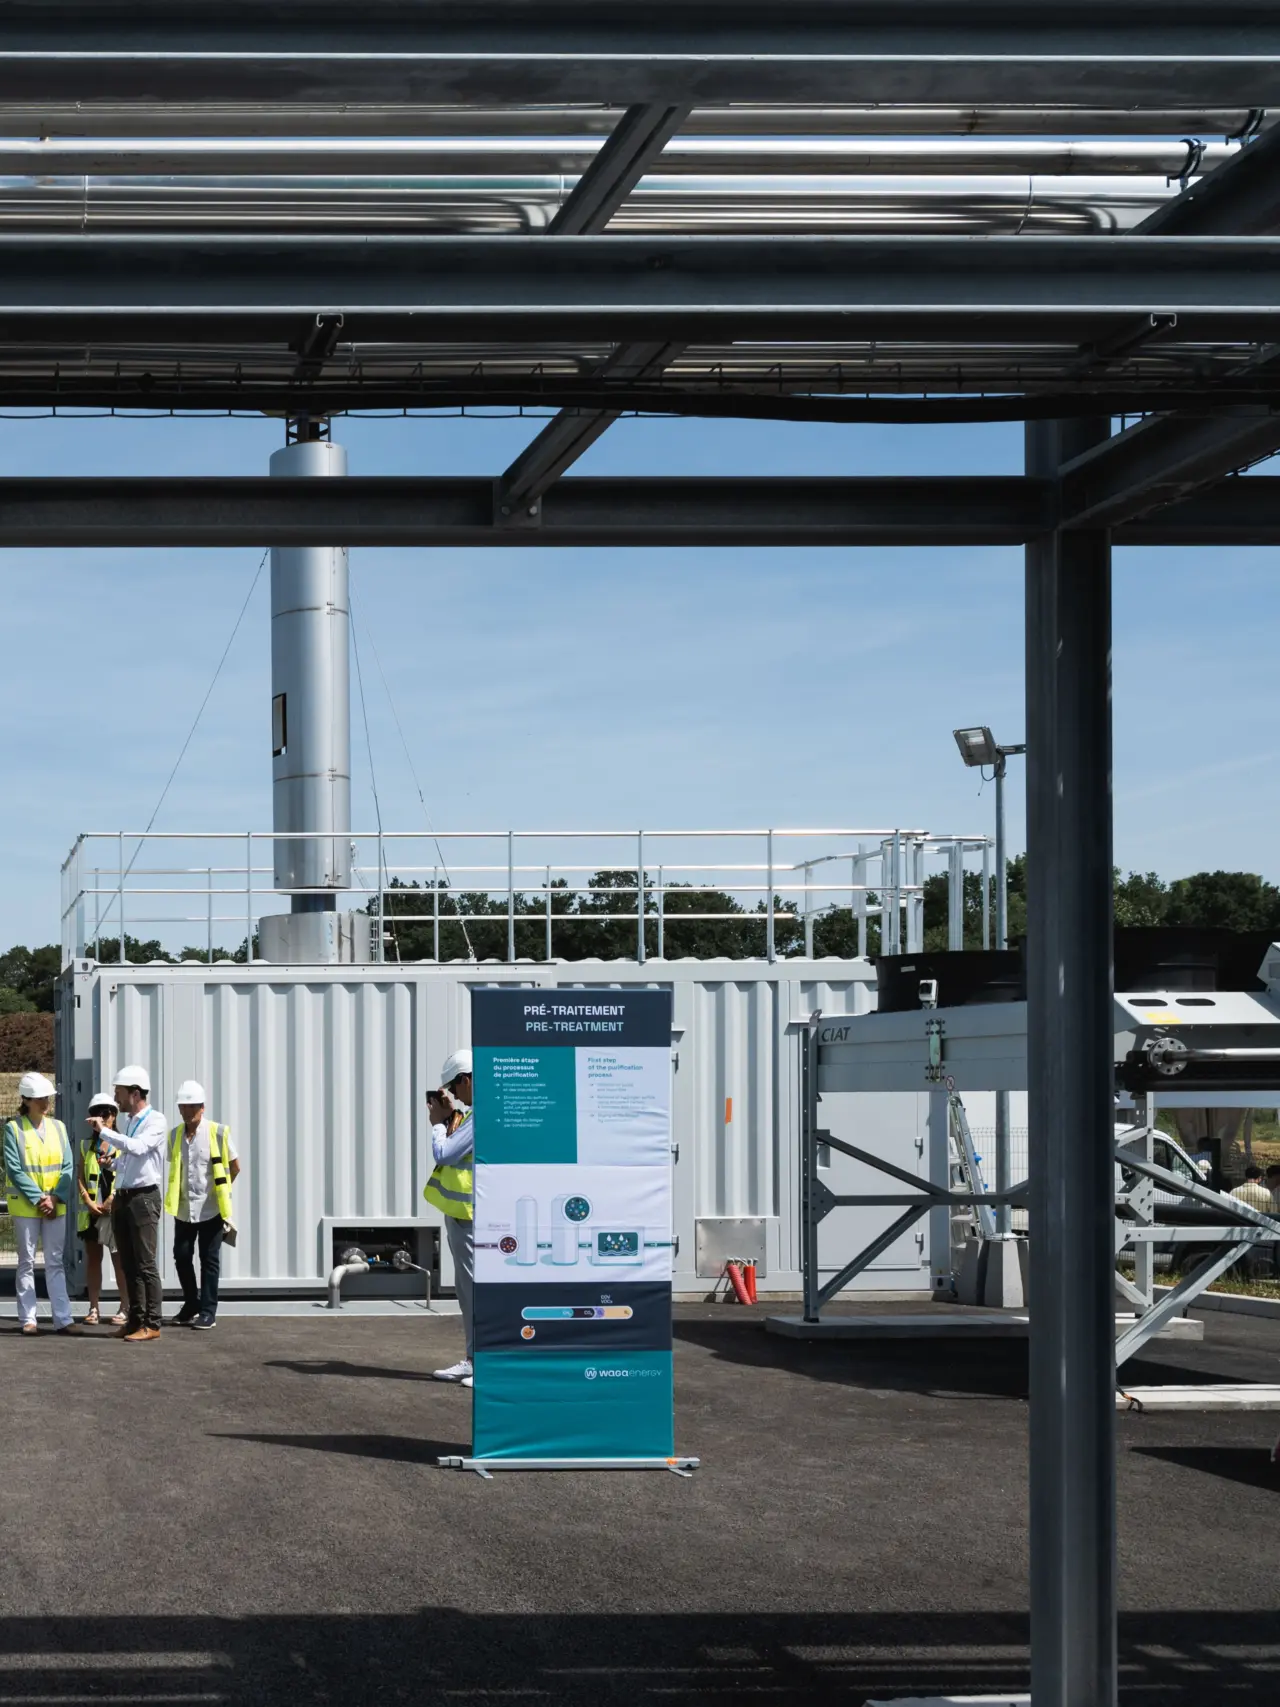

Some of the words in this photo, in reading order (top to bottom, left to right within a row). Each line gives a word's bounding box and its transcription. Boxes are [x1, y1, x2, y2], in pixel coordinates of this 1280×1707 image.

[523, 1003, 626, 1016] PRÉ-TRAITEMENT
[525, 1021, 625, 1032] PRE-TREATMENT
[821, 1026, 851, 1043] CIAT
